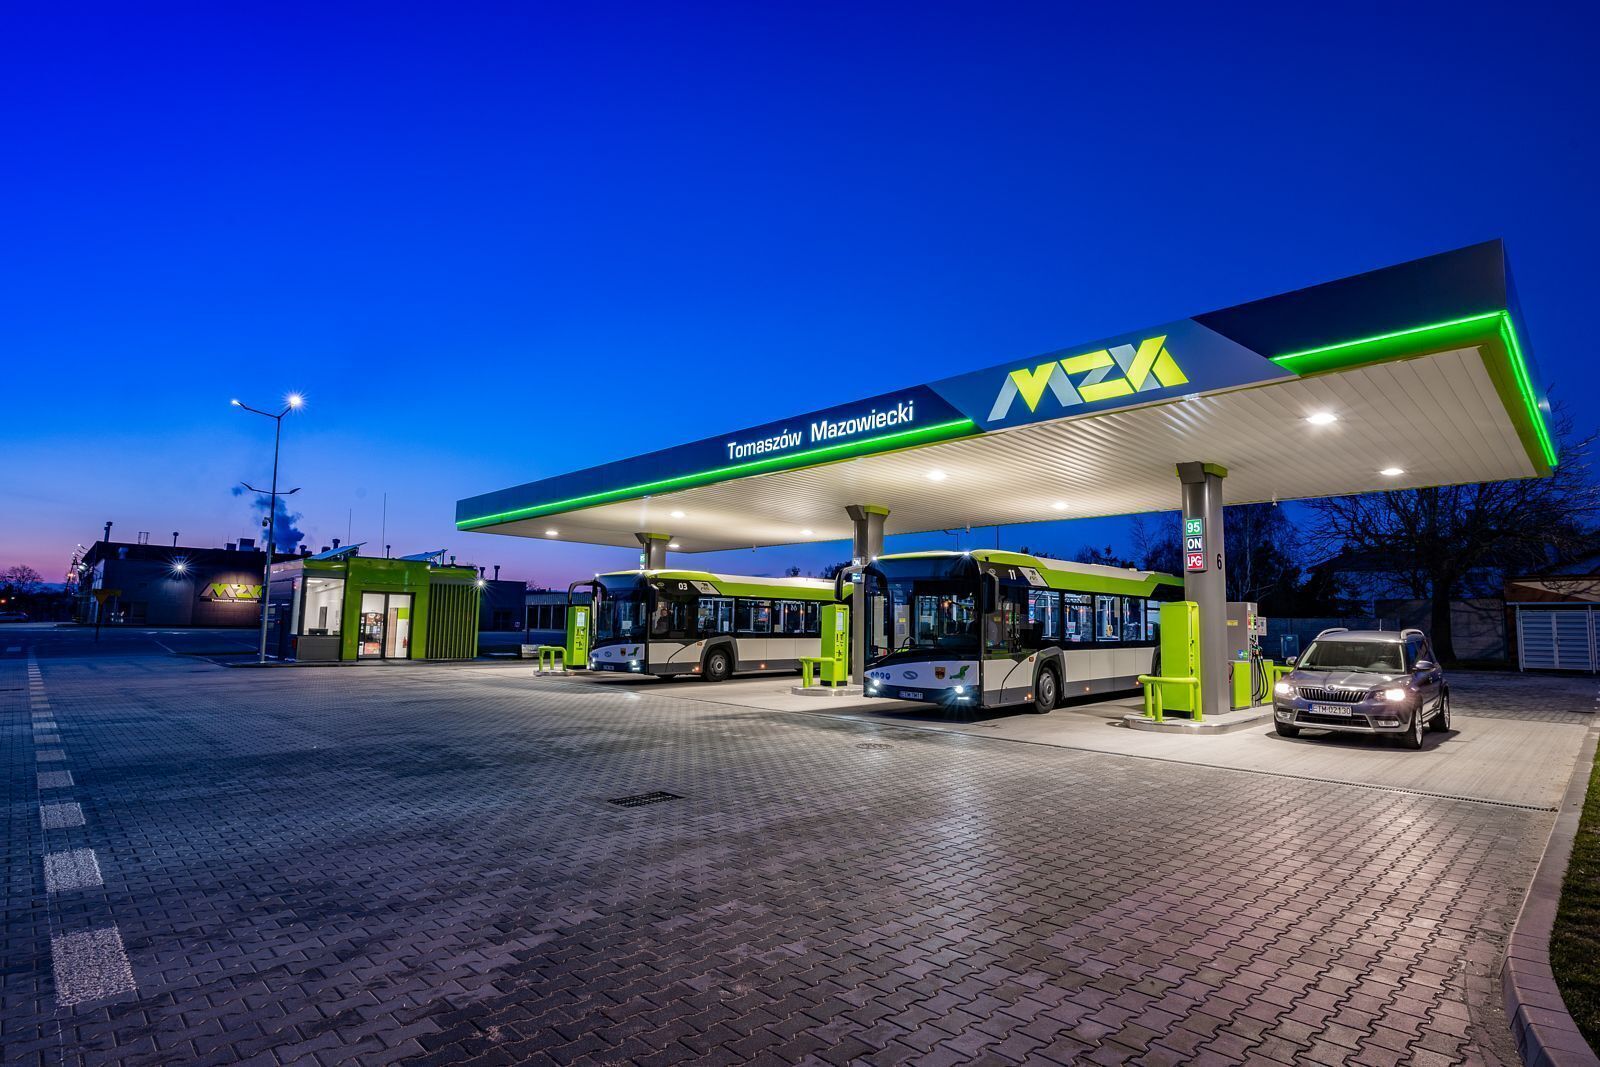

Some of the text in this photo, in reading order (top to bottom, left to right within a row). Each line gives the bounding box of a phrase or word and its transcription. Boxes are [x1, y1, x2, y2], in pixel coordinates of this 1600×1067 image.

[987, 335, 1189, 422] MZK
[728, 400, 914, 459] Tomaszów Mazowiecki
[1187, 522, 1200, 533] 95
[1187, 538, 1201, 549] ON
[1187, 555, 1202, 566] LPG
[1216, 553, 1222, 570] 6
[1008, 569, 1017, 580] 11
[678, 582, 688, 590] 03
